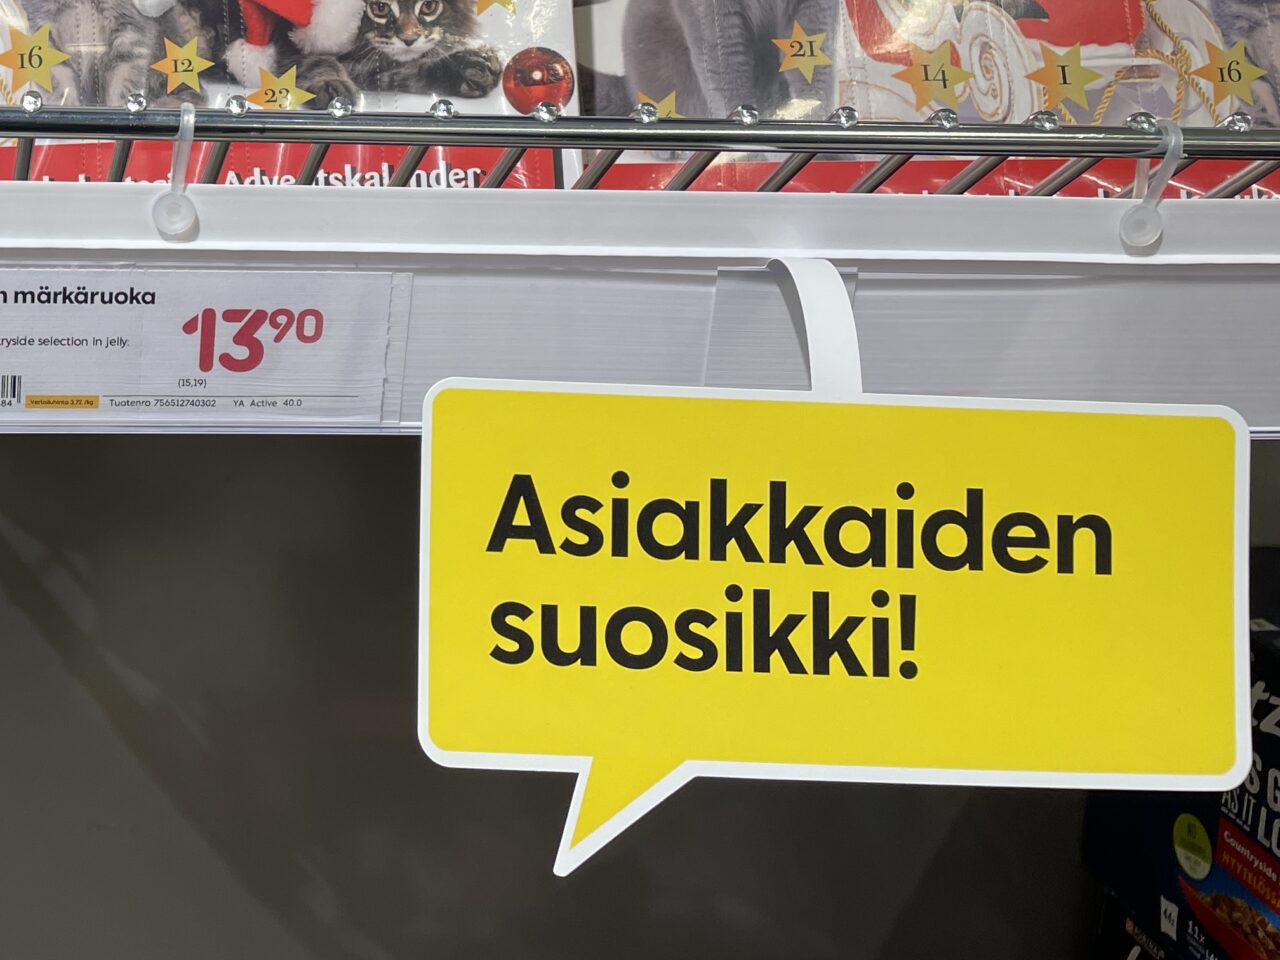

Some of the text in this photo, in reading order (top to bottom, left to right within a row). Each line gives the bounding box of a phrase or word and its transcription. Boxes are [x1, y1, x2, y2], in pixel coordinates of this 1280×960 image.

[17, 45, 43, 70] 16
[788, 39, 818, 58] 21
[171, 58, 195, 74] 12
[1218, 61, 1242, 83] 16
[921, 63, 949, 89] 14
[14, 286, 156, 305] märkäruoka
[38, 336, 89, 347] selection
[92, 337, 103, 347] in
[178, 378, 207, 389] (15,19)
[109, 398, 216, 407] Tuotenro 756512740302
[233, 399, 245, 407] YA
[249, 399, 278, 407] Active
[485, 470, 1113, 576] Asiakkaiden
[489, 583, 919, 680] suosikki!
